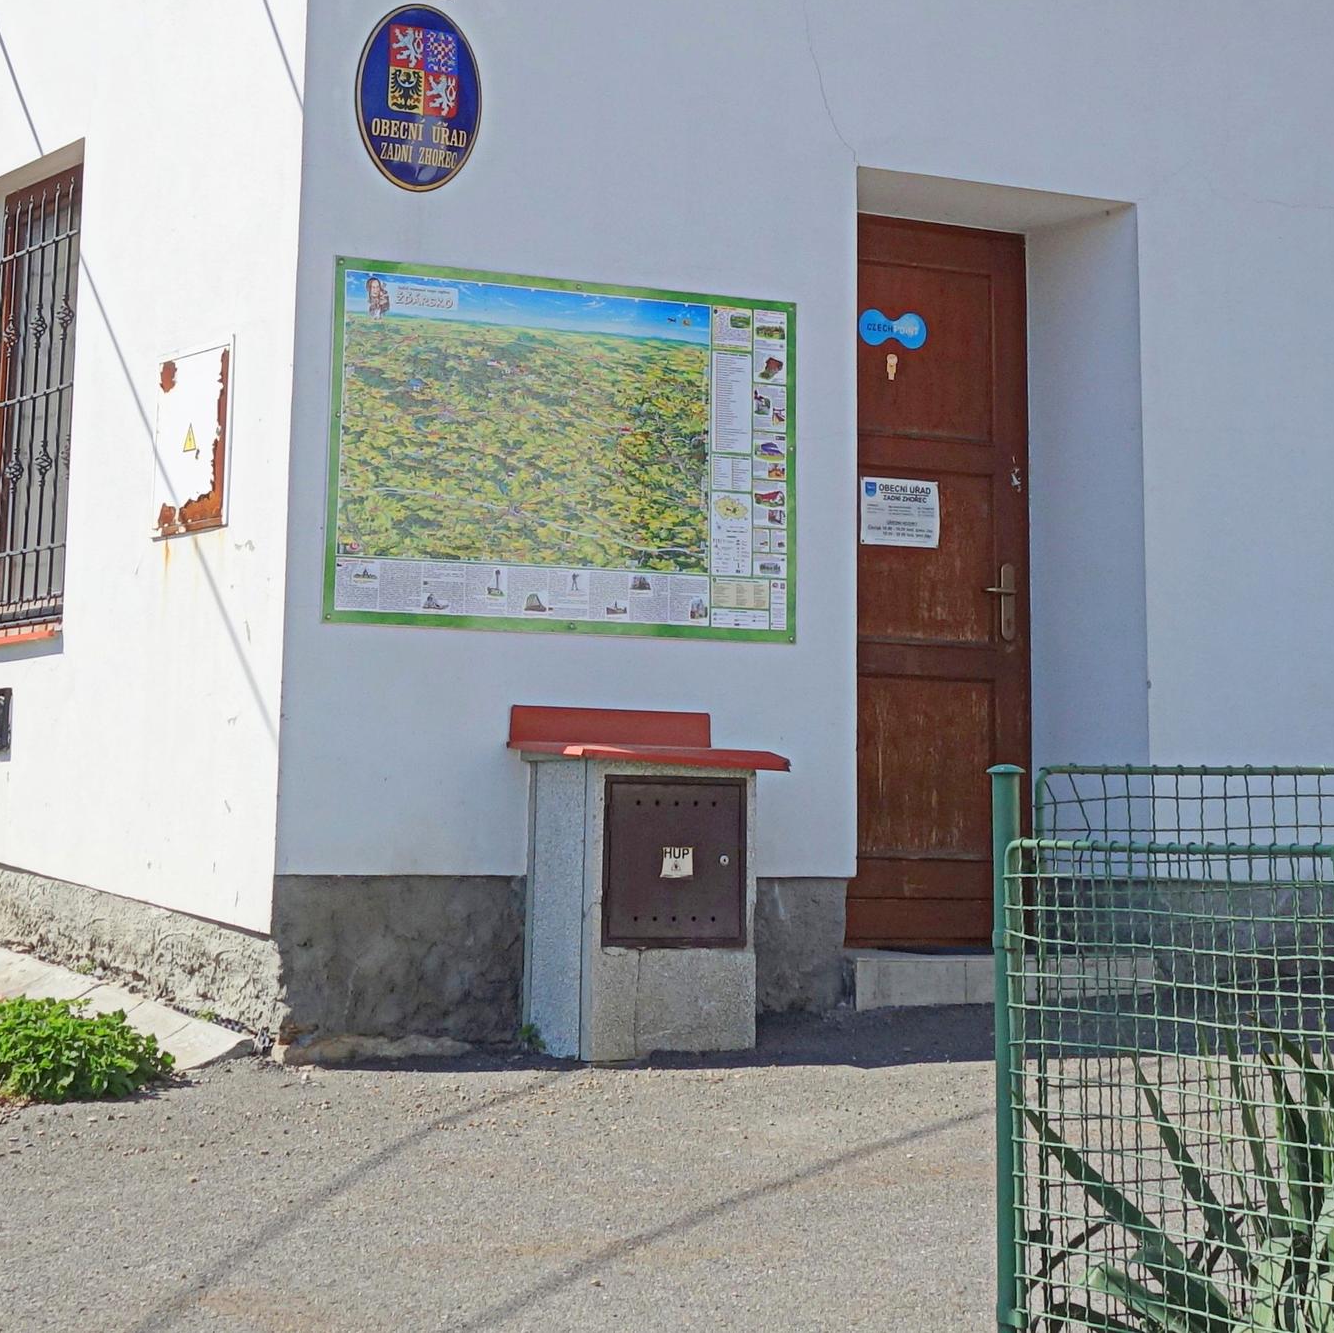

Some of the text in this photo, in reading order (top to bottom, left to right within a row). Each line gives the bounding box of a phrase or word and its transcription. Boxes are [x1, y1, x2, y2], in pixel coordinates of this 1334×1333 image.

[371, 117, 467, 147] OBECNÍ ÚŘAD
[380, 141, 458, 169] ZADNÍ ZHOŘEC
[878, 483, 908, 492] OBECNÍ
[664, 848, 690, 859] HUP
